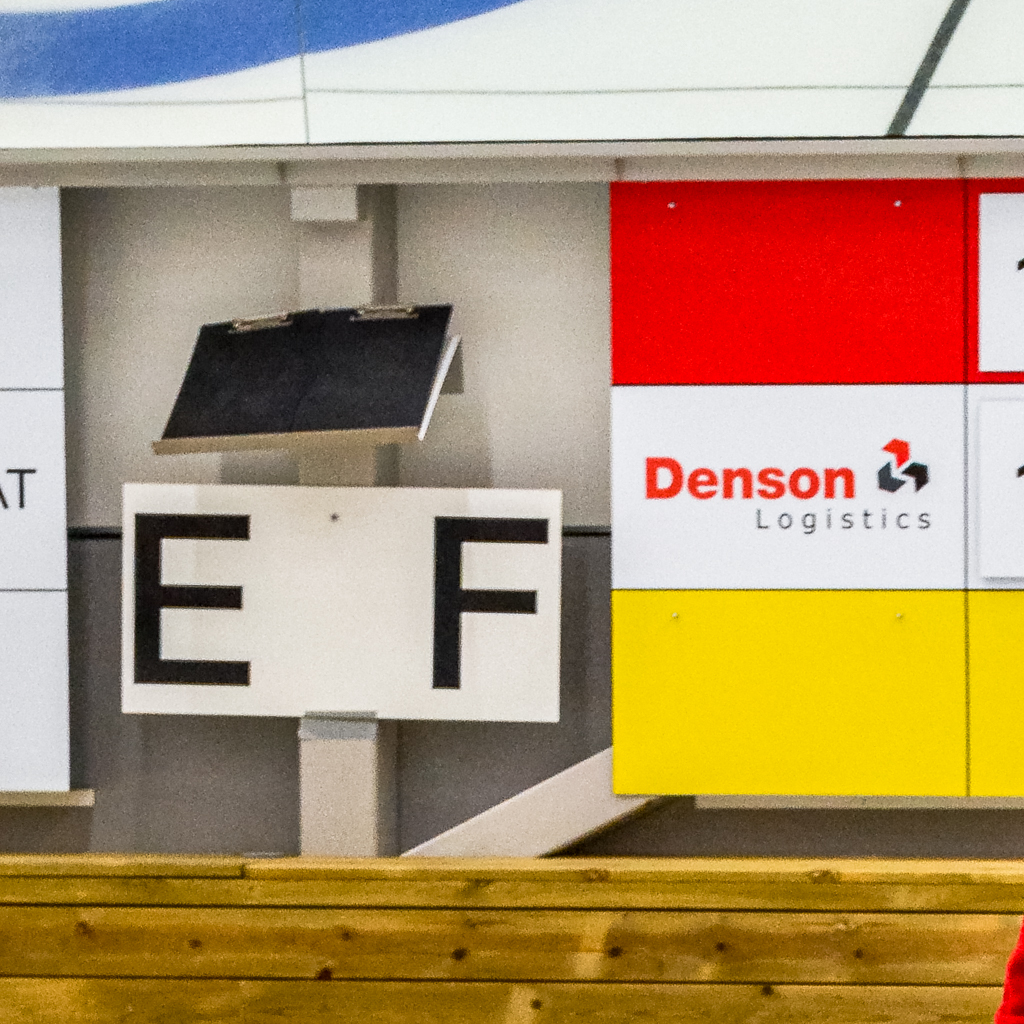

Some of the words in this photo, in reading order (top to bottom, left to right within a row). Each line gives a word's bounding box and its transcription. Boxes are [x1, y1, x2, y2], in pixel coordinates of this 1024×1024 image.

[645, 456, 855, 499] Denson
[756, 508, 931, 535] Logistics
[134, 513, 250, 687] E
[433, 515, 549, 690] F
